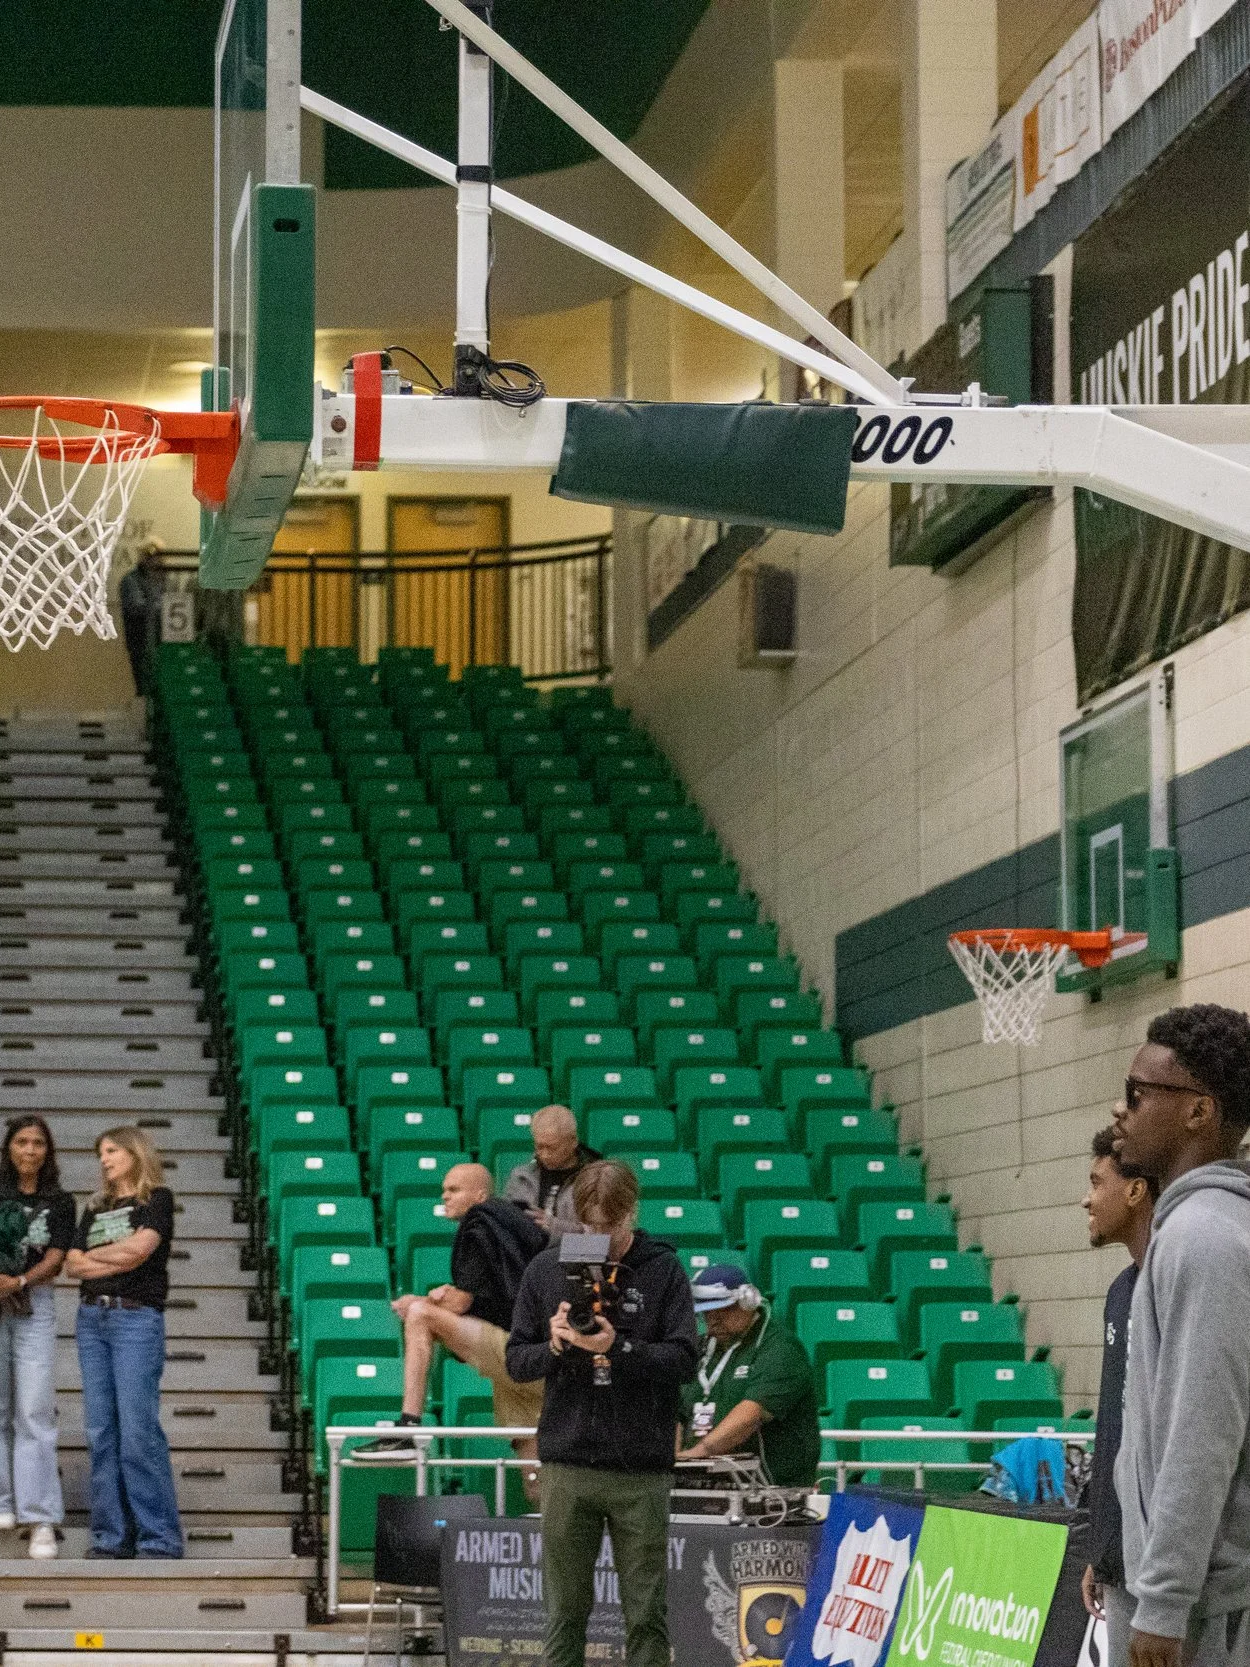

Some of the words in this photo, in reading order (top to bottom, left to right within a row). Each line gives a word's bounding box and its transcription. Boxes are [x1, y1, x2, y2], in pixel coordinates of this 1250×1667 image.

[1172, 230, 1250, 405] PRIDE
[851, 414, 953, 464] 000
[167, 603, 188, 631] 5
[455, 1530, 523, 1563] ARMED
[732, 1541, 778, 1555] ARMED
[732, 1559, 804, 1580] HARMON
[85, 1635, 95, 1646] K
